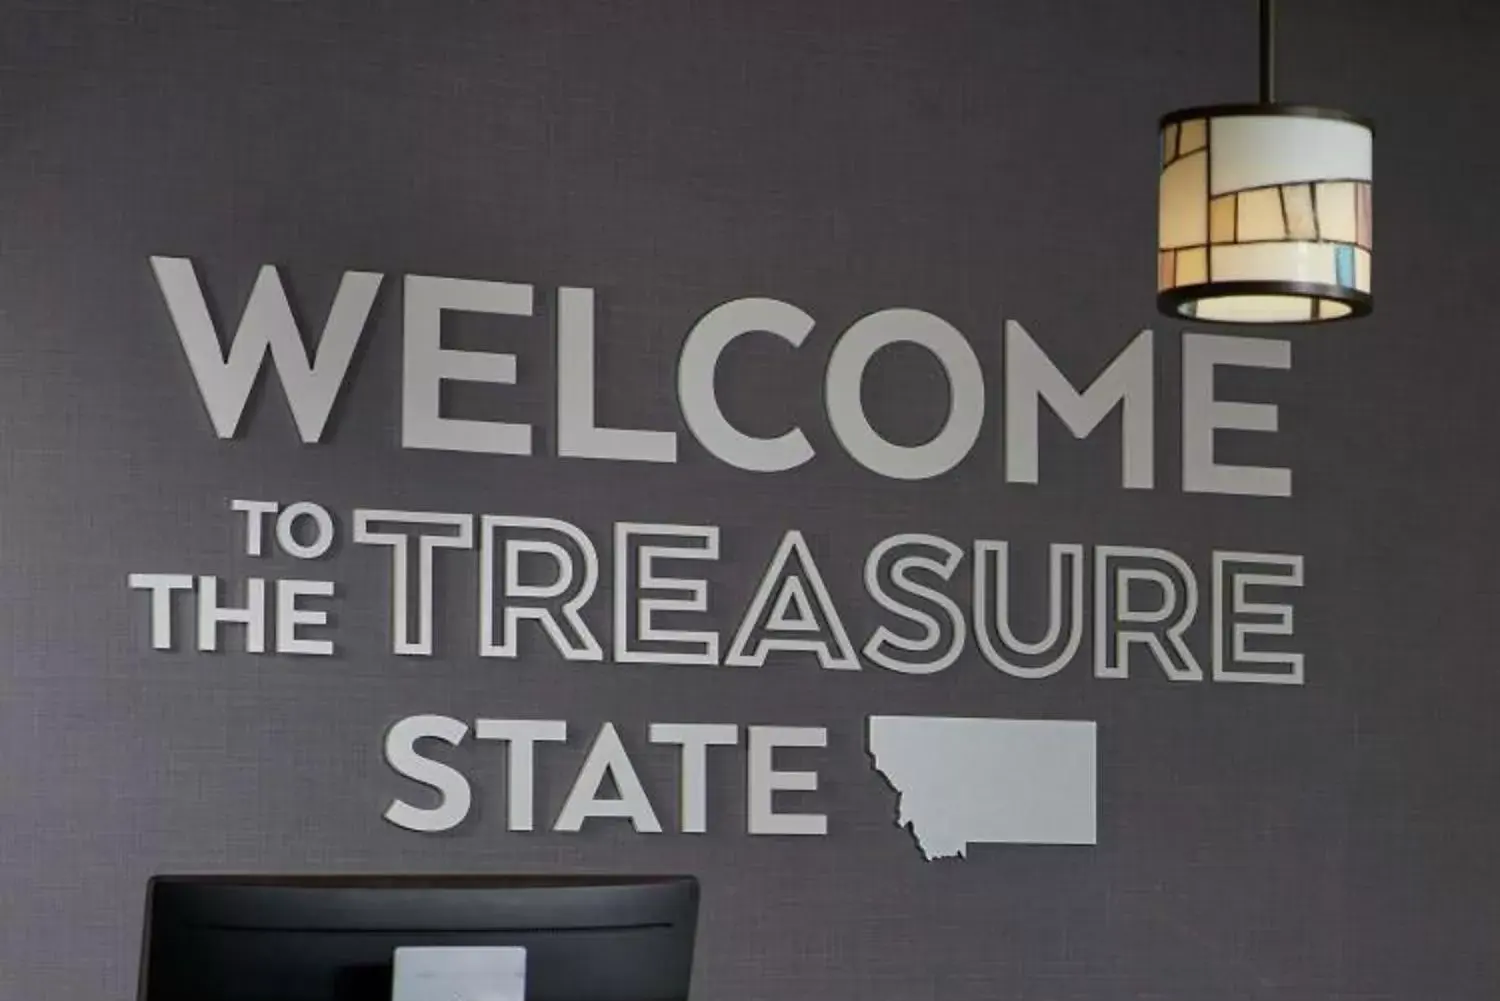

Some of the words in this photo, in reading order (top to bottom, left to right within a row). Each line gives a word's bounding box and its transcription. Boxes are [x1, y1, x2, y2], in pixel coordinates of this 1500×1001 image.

[150, 256, 1292, 497] WELCOME
[230, 499, 334, 559] TO
[128, 573, 335, 656] THE
[353, 508, 1305, 685] TREASURE
[385, 713, 828, 835] STATE
